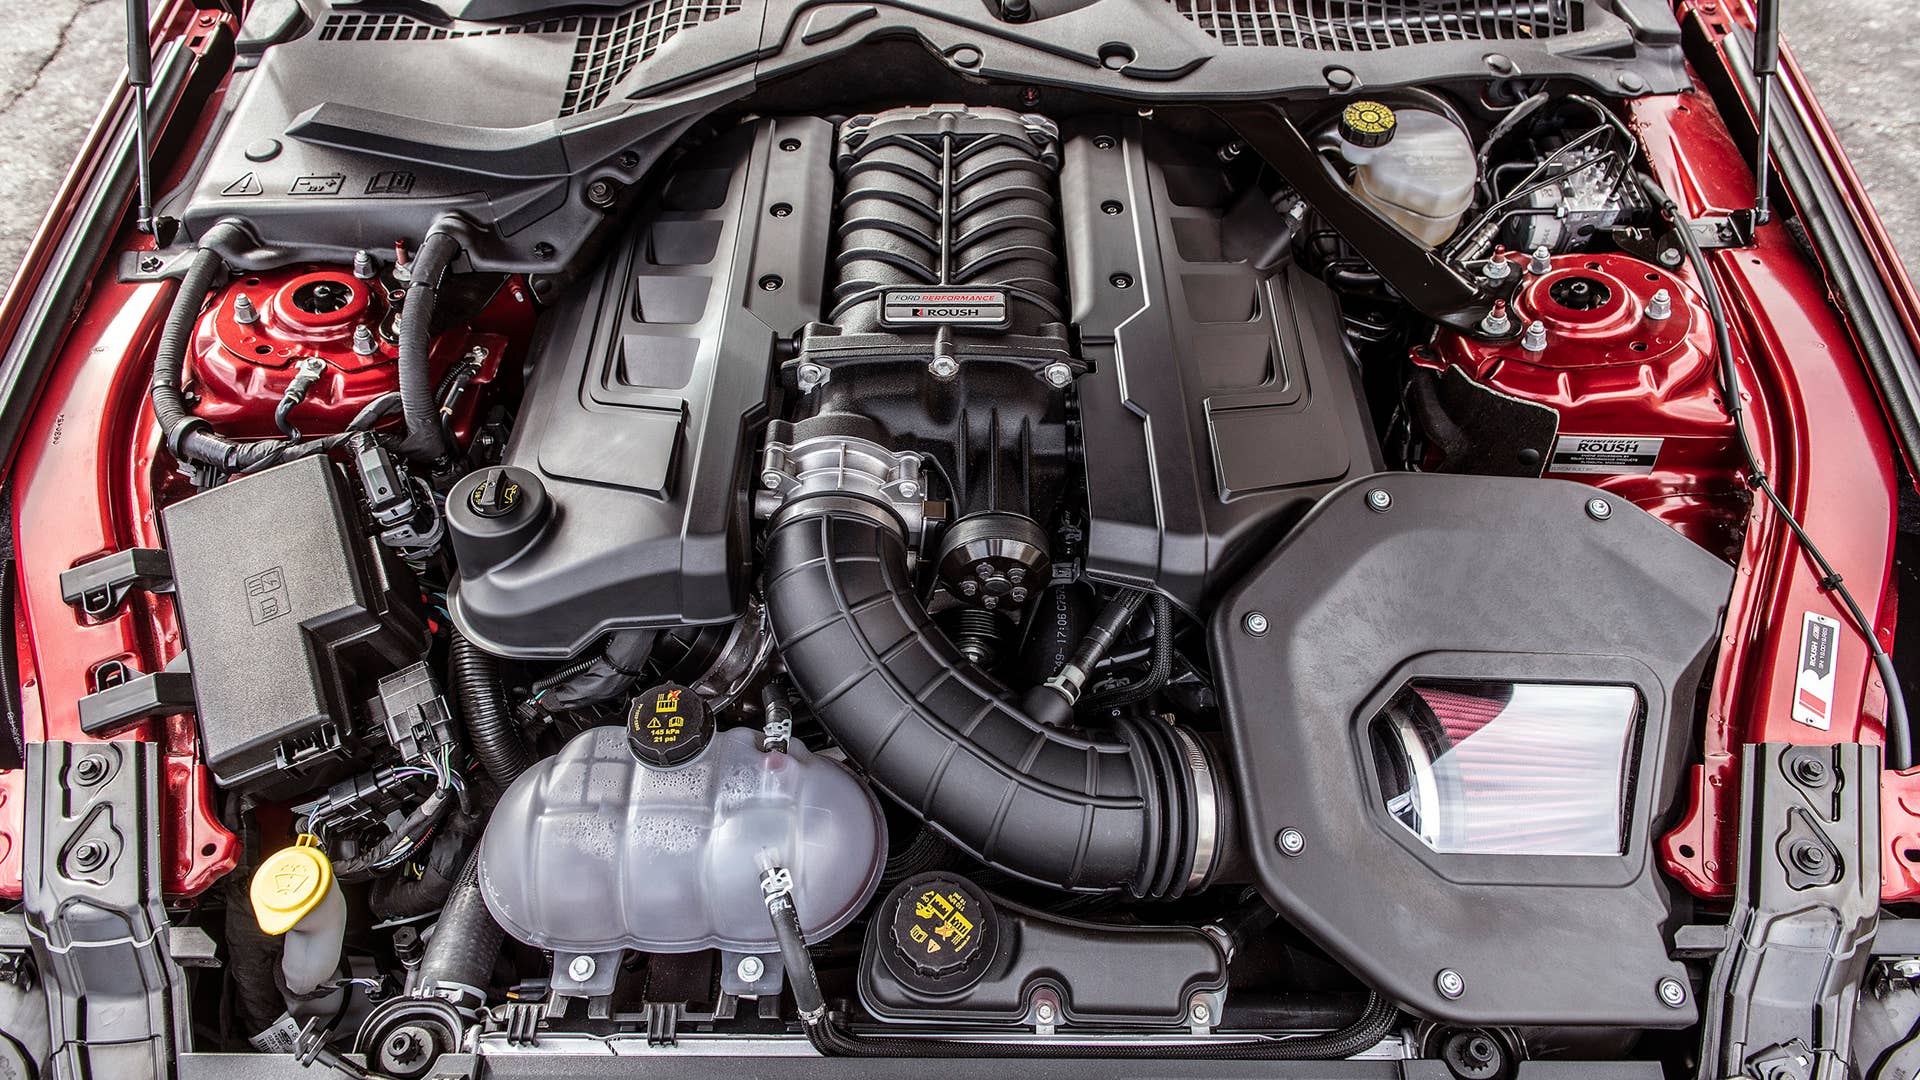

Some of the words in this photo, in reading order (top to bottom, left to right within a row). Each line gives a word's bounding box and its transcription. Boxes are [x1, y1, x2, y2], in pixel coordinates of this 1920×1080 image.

[894, 294, 921, 302] FORD
[921, 294, 996, 302] PERFORMANCE
[927, 308, 979, 317] ROUSH
[1576, 443, 1640, 453] ROUSH
[1056, 613, 1067, 645] 17:06
[1809, 641, 1818, 667] ROUSH
[664, 735, 677, 743] psi
